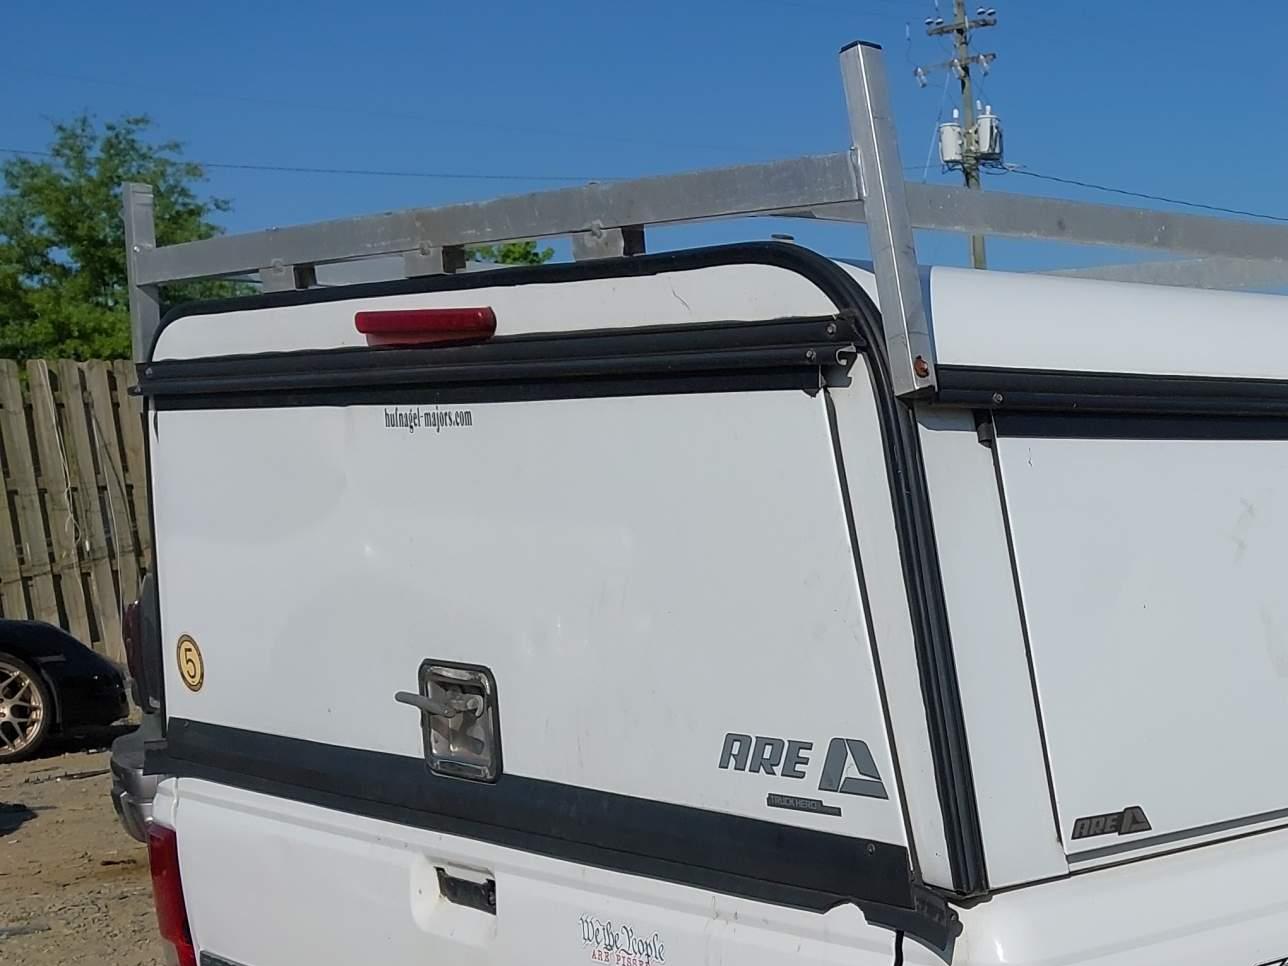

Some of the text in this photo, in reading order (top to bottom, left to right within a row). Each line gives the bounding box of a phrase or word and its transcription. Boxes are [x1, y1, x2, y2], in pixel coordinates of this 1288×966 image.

[384, 406, 473, 433] hufnagel-majors.com
[184, 647, 197, 679] 5
[718, 732, 814, 780] ARE
[1072, 815, 1120, 840] ARE
[579, 916, 603, 945] We
[591, 950, 610, 963] ARE
